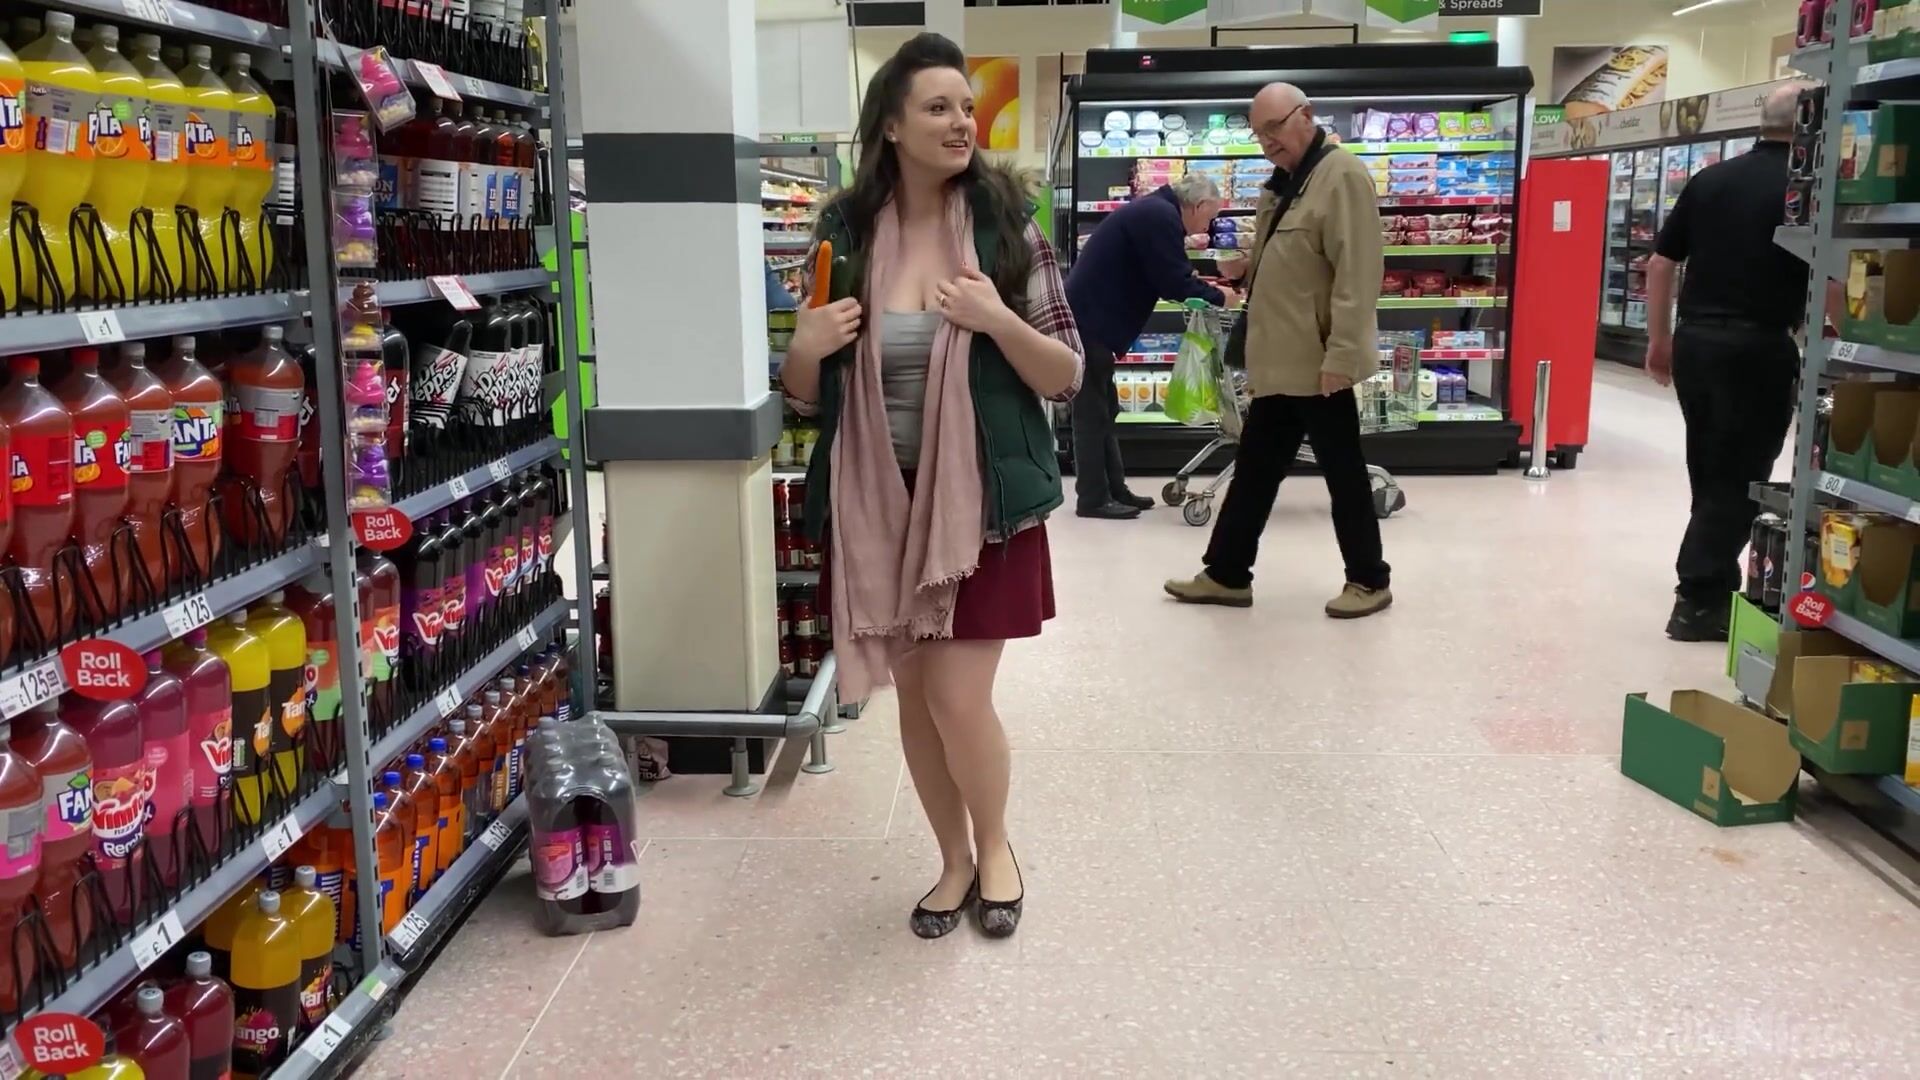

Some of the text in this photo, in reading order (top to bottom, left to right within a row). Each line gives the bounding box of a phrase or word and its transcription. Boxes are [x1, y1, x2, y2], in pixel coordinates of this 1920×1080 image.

[1450, 0, 1503, 11] Spreads
[1534, 114, 1561, 124] LOW
[99, 317, 111, 335] £1
[365, 514, 395, 528] Roll
[364, 525, 402, 542] Back
[1795, 603, 1823, 622] Back
[1803, 595, 1825, 612] Roll
[80, 651, 121, 669] Roll
[77, 669, 131, 687] Back
[278, 823, 293, 849] £1
[152, 920, 173, 956] £1
[33, 1022, 77, 1045] Roll
[323, 1023, 343, 1049] £1
[33, 1041, 90, 1063] Back
